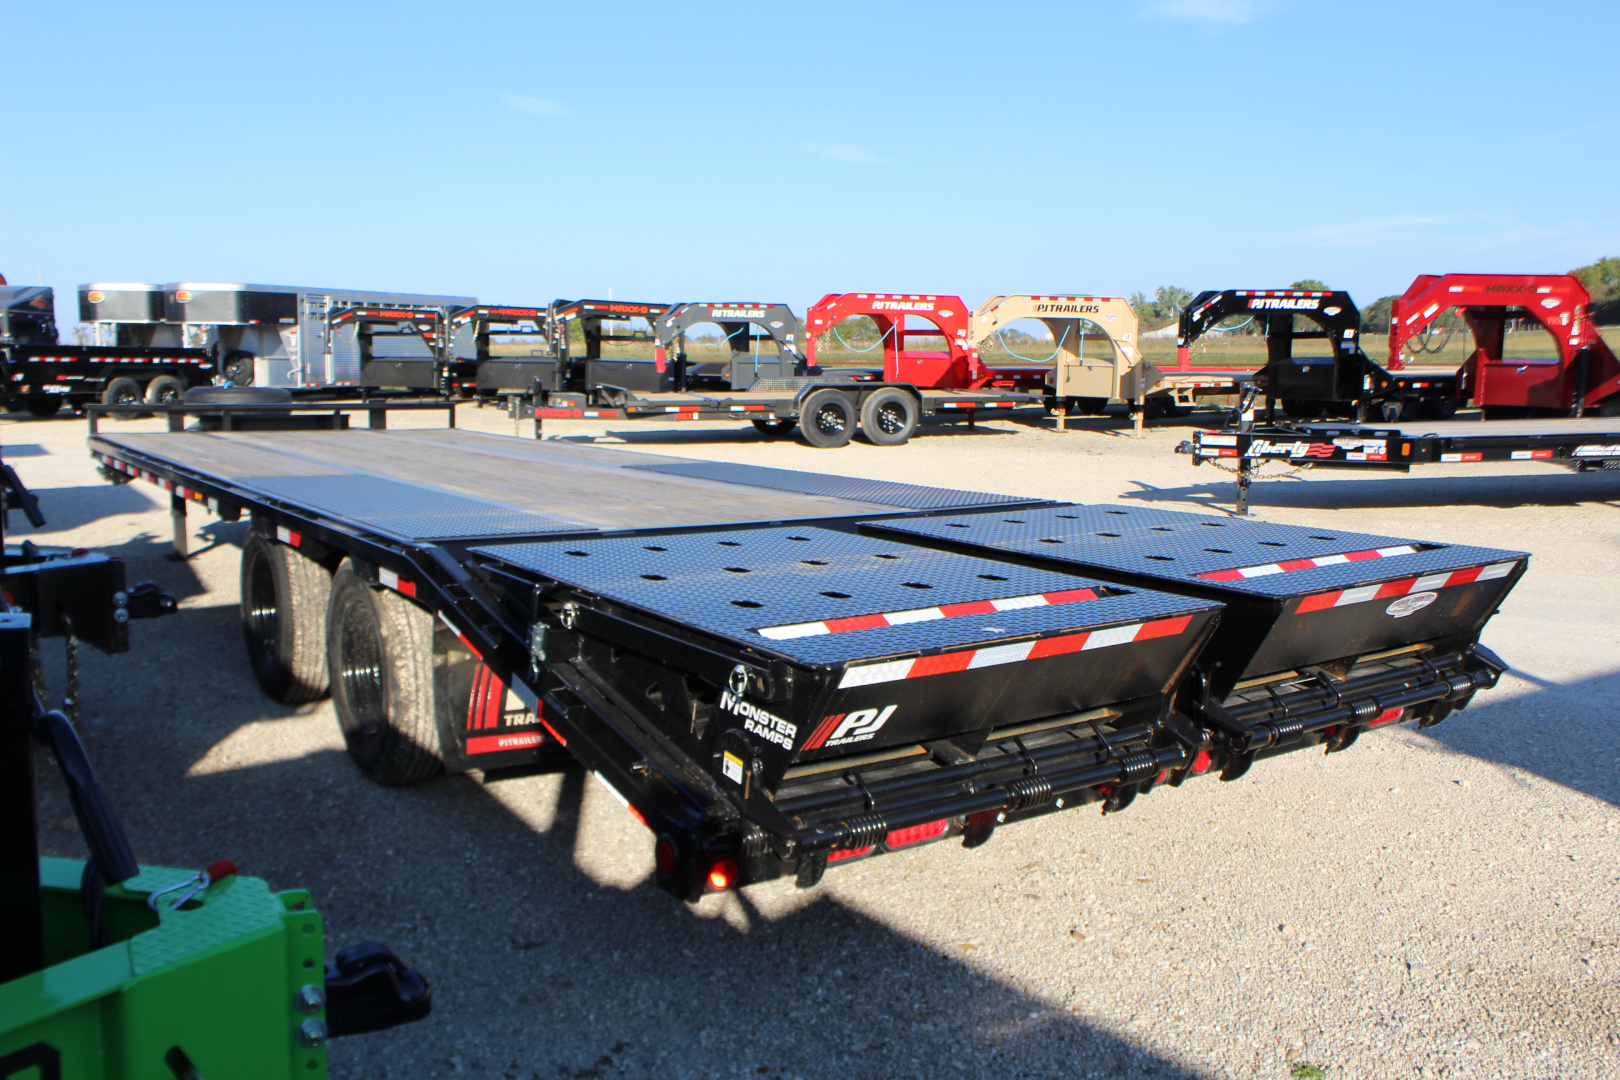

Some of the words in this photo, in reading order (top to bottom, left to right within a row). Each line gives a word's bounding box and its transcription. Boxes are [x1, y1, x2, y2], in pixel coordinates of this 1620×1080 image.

[1484, 285, 1536, 294] MAXX-D
[1244, 439, 1311, 458] Liberty
[720, 691, 798, 739] MONSTER
[830, 704, 898, 740] PJ
[744, 718, 793, 751] RAMPS
[825, 732, 876, 748] TRAILERS
